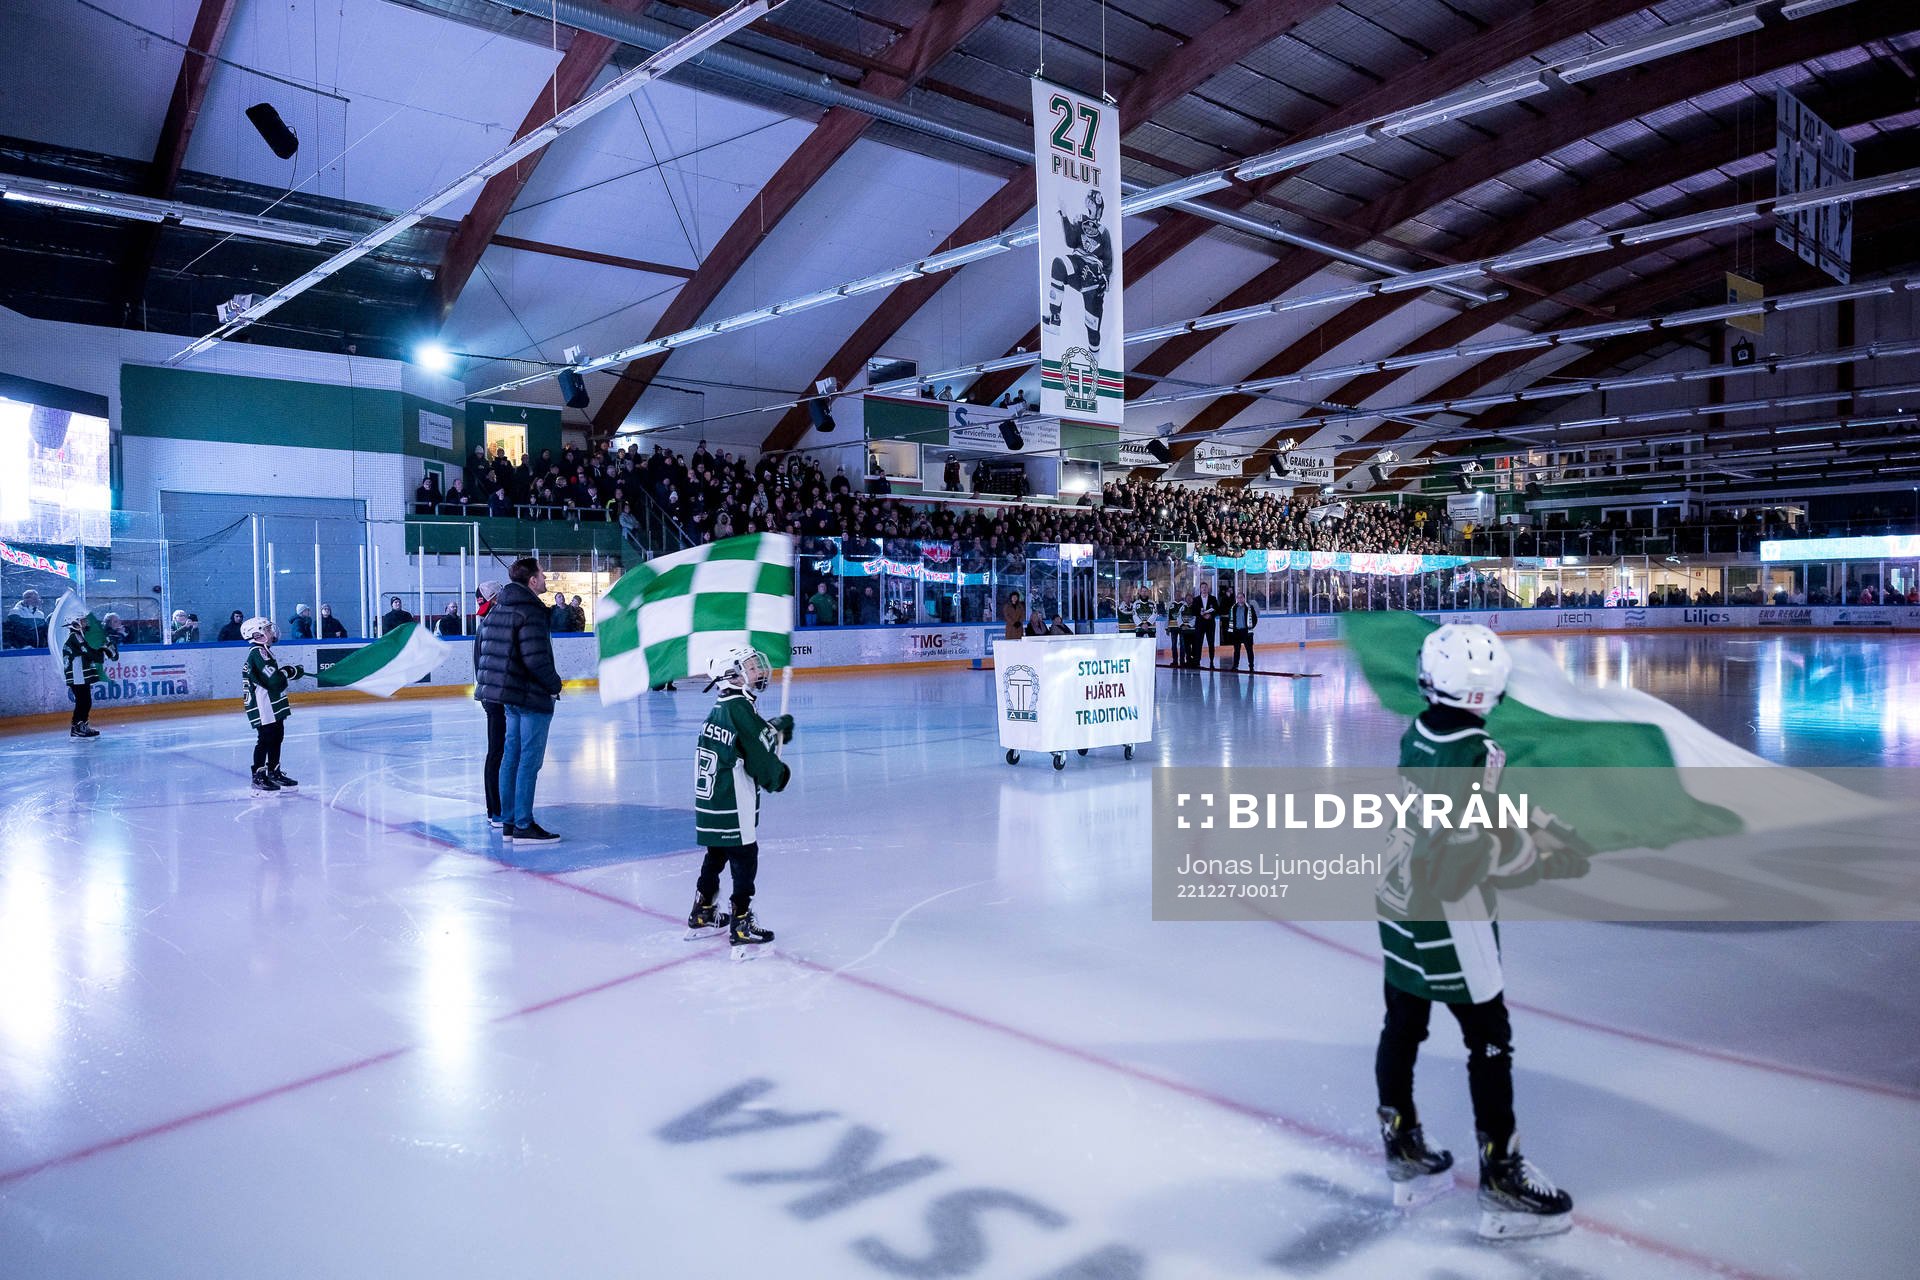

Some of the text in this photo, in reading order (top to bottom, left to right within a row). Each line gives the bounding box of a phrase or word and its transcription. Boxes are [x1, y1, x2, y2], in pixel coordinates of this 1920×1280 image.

[1049, 93, 1101, 162] 27
[1051, 153, 1102, 187] PILUT
[1684, 609, 1730, 626] Liljas
[911, 634, 943, 648] TMG
[1078, 659, 1131, 676] STOLTHET
[1085, 681, 1126, 700] HJÄRTA
[1075, 706, 1139, 725] TRADITION
